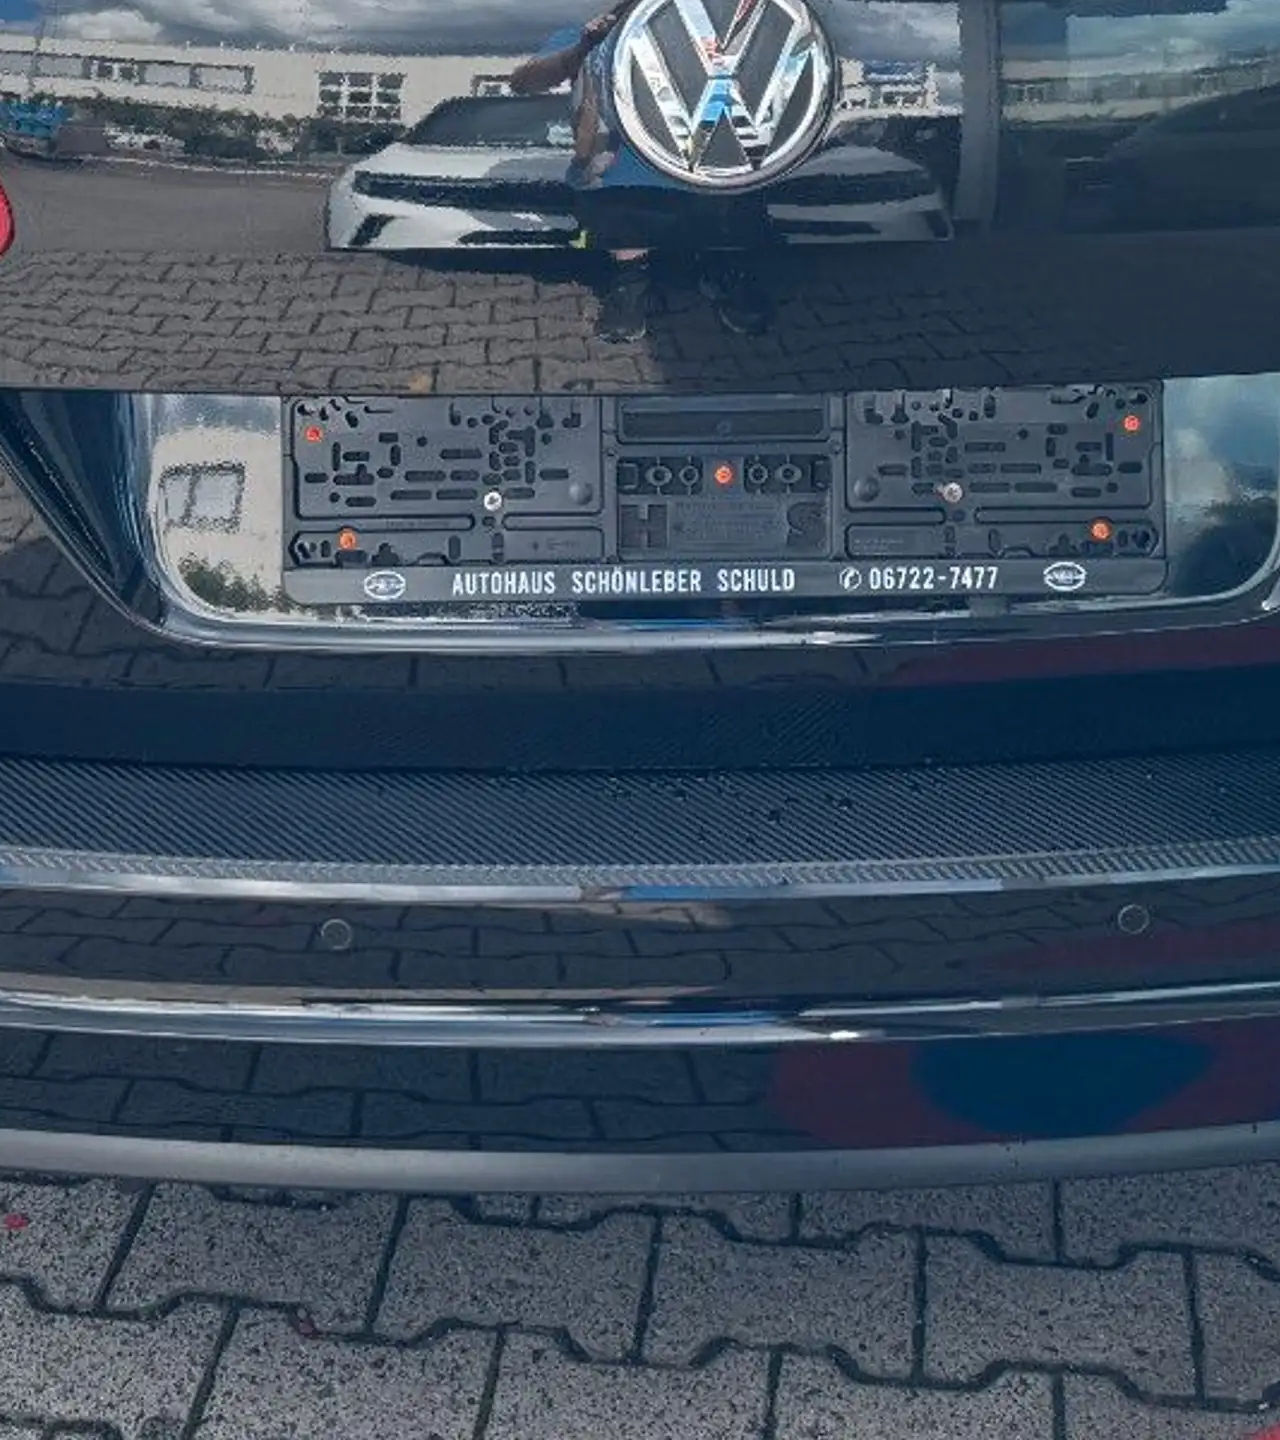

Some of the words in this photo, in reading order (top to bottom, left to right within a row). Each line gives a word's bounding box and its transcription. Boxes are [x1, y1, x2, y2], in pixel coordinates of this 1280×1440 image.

[451, 570, 557, 596] AUTOHAUS
[571, 566, 702, 594] SCHÖNLEBER
[717, 568, 795, 592] SCHULD
[868, 566, 999, 590] 06722-7477
